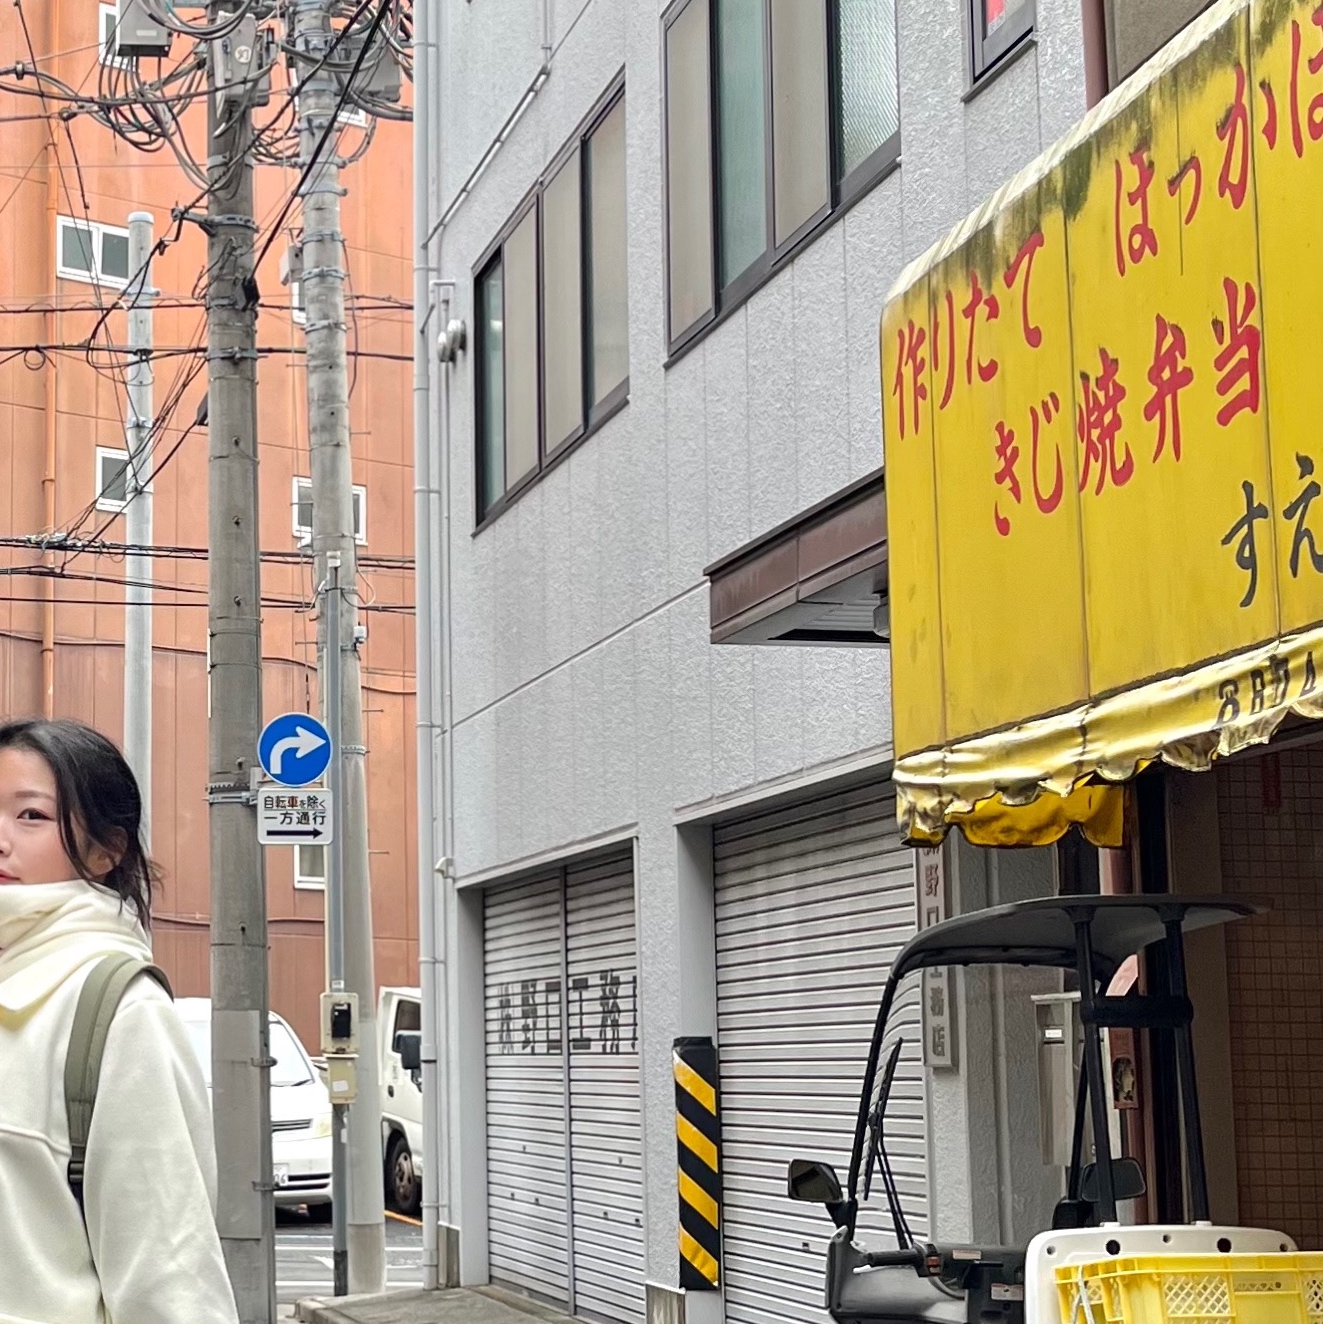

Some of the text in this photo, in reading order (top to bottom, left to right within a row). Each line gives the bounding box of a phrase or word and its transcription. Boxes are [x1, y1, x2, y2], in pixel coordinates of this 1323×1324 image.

[893, 231, 1043, 440] 作りたて
[994, 277, 1261, 537] きじ焼弁当
[264, 795, 326, 809] 自転車を除く
[264, 811, 327, 825] 一方通行
